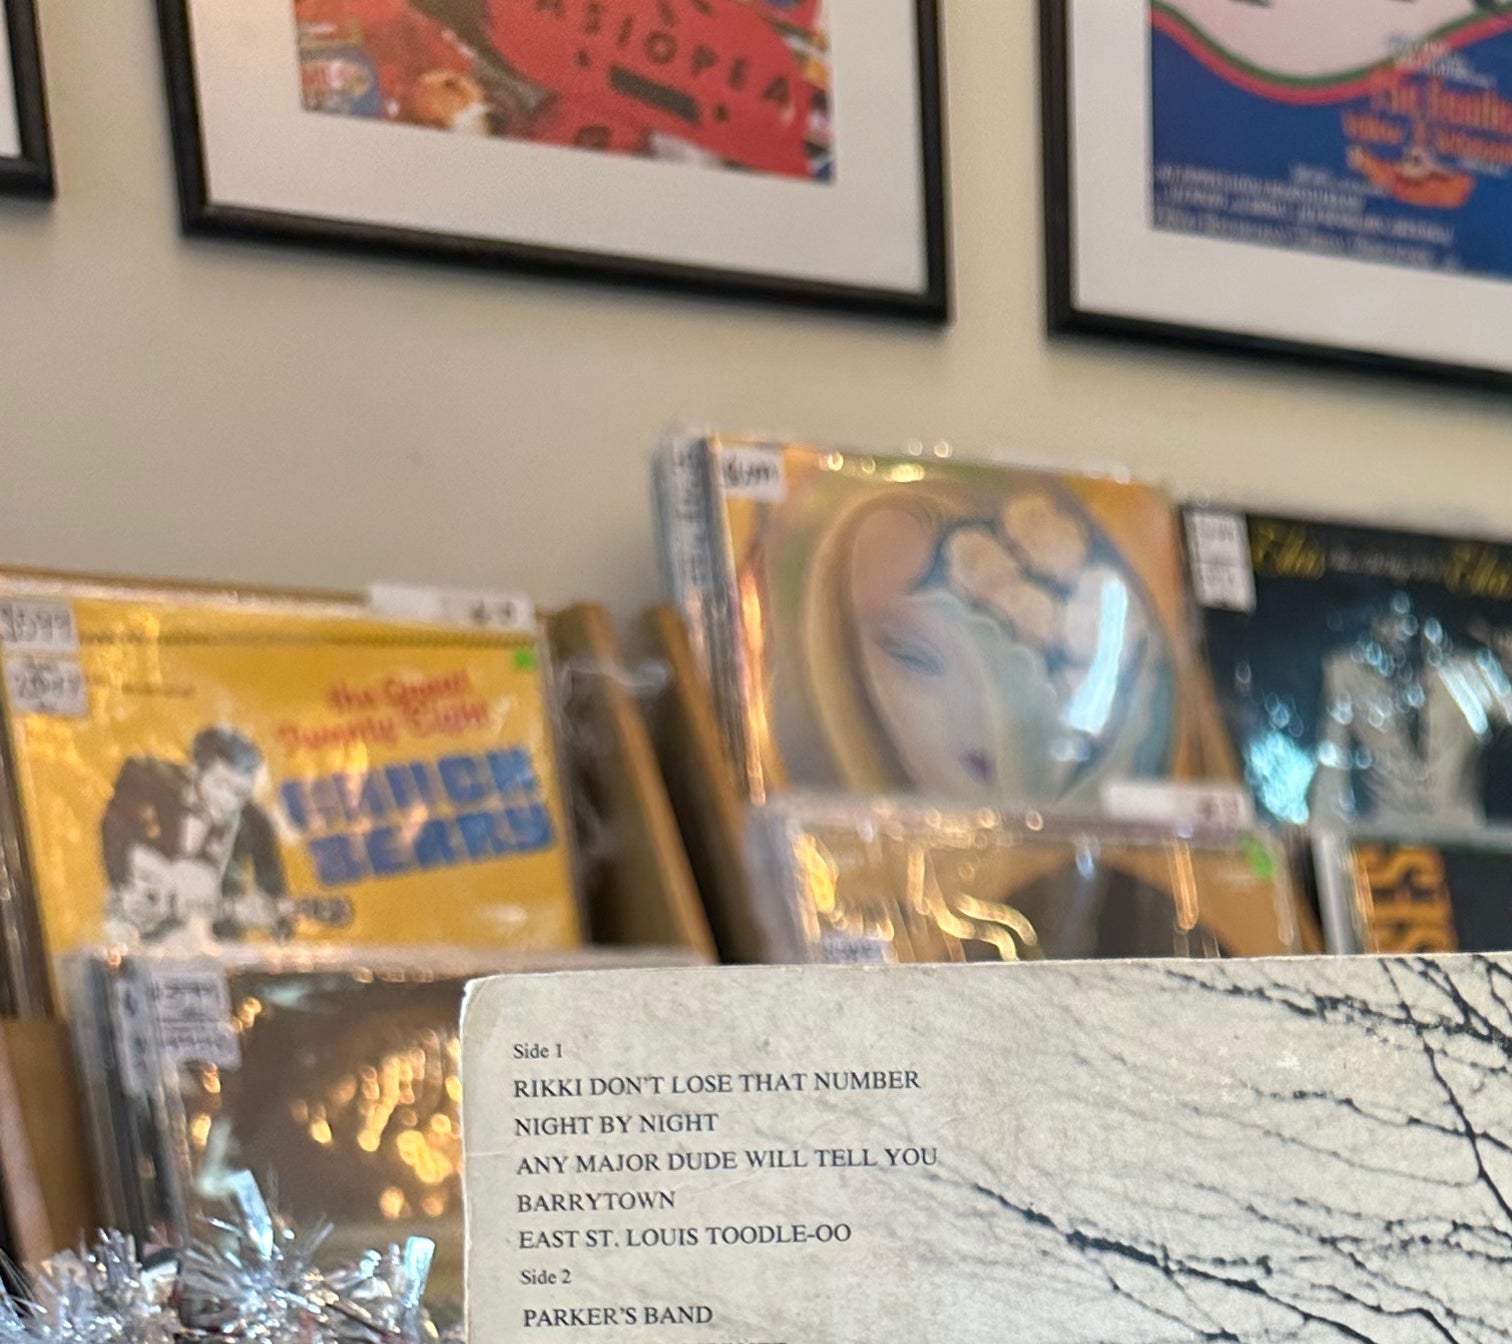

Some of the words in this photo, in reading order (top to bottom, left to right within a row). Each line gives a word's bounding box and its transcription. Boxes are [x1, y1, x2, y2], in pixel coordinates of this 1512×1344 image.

[513, 1042, 549, 1059] Side
[555, 1043, 563, 1058] 1
[513, 1078, 583, 1098] RIKKI
[672, 1074, 732, 1094] LOSE
[739, 1072, 807, 1092] THAT
[813, 1070, 921, 1091] NUMBER
[515, 1116, 592, 1136] NIGHT
[600, 1115, 632, 1134] BY
[639, 1113, 719, 1133] NIGHT
[517, 1155, 568, 1174] ANY
[576, 1153, 659, 1173] MAJOR
[668, 1151, 737, 1170] DUDE
[745, 1150, 807, 1169] WILL
[815, 1148, 877, 1168] TELL
[884, 1147, 937, 1166] YOU
[518, 1191, 676, 1213] BARRYTOWN
[518, 1230, 579, 1249] EAST
[585, 1229, 619, 1248] ST.
[626, 1228, 699, 1247] LOUIS
[706, 1224, 851, 1245] TOODLE-OO
[521, 1269, 556, 1285] Side
[561, 1269, 571, 1284] 2
[644, 1305, 713, 1325] BAND
